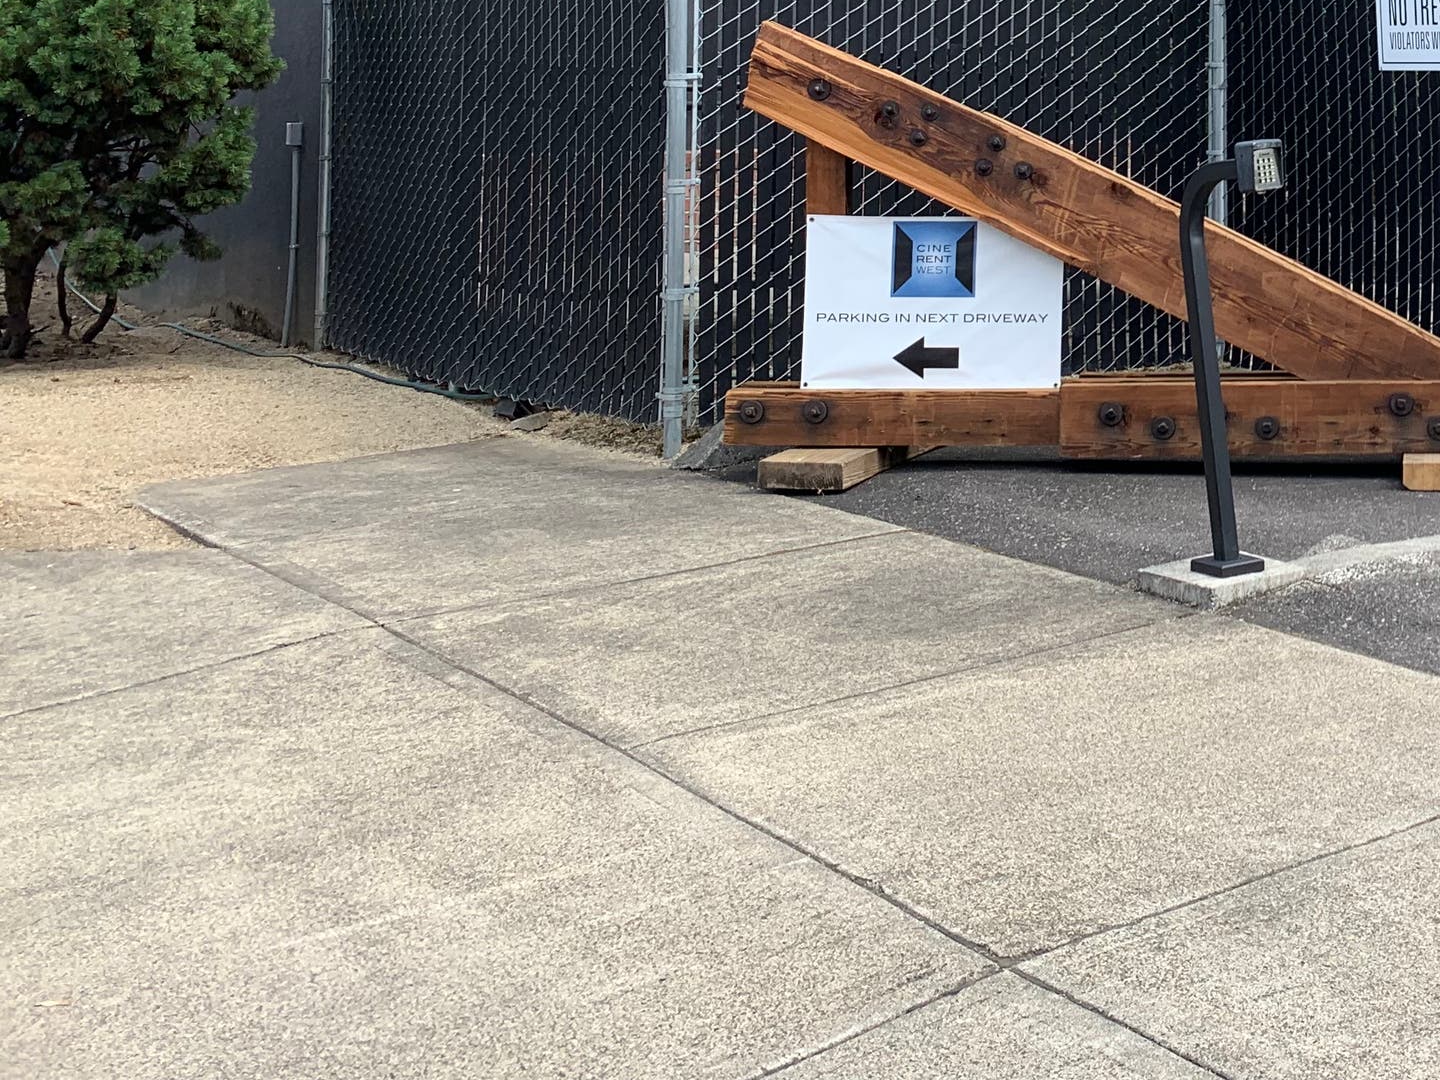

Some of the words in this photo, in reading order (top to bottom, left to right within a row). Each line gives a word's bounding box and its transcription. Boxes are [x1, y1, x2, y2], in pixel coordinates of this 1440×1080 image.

[1389, 31, 1430, 50] VIOLATORS
[916, 243, 951, 253] CINE
[916, 254, 952, 264] RENT
[916, 265, 951, 275] WEST
[816, 312, 890, 323] PARKING
[894, 312, 911, 323] IN
[915, 313, 959, 324] NEXT
[963, 313, 1048, 324] DRIVEWAY
